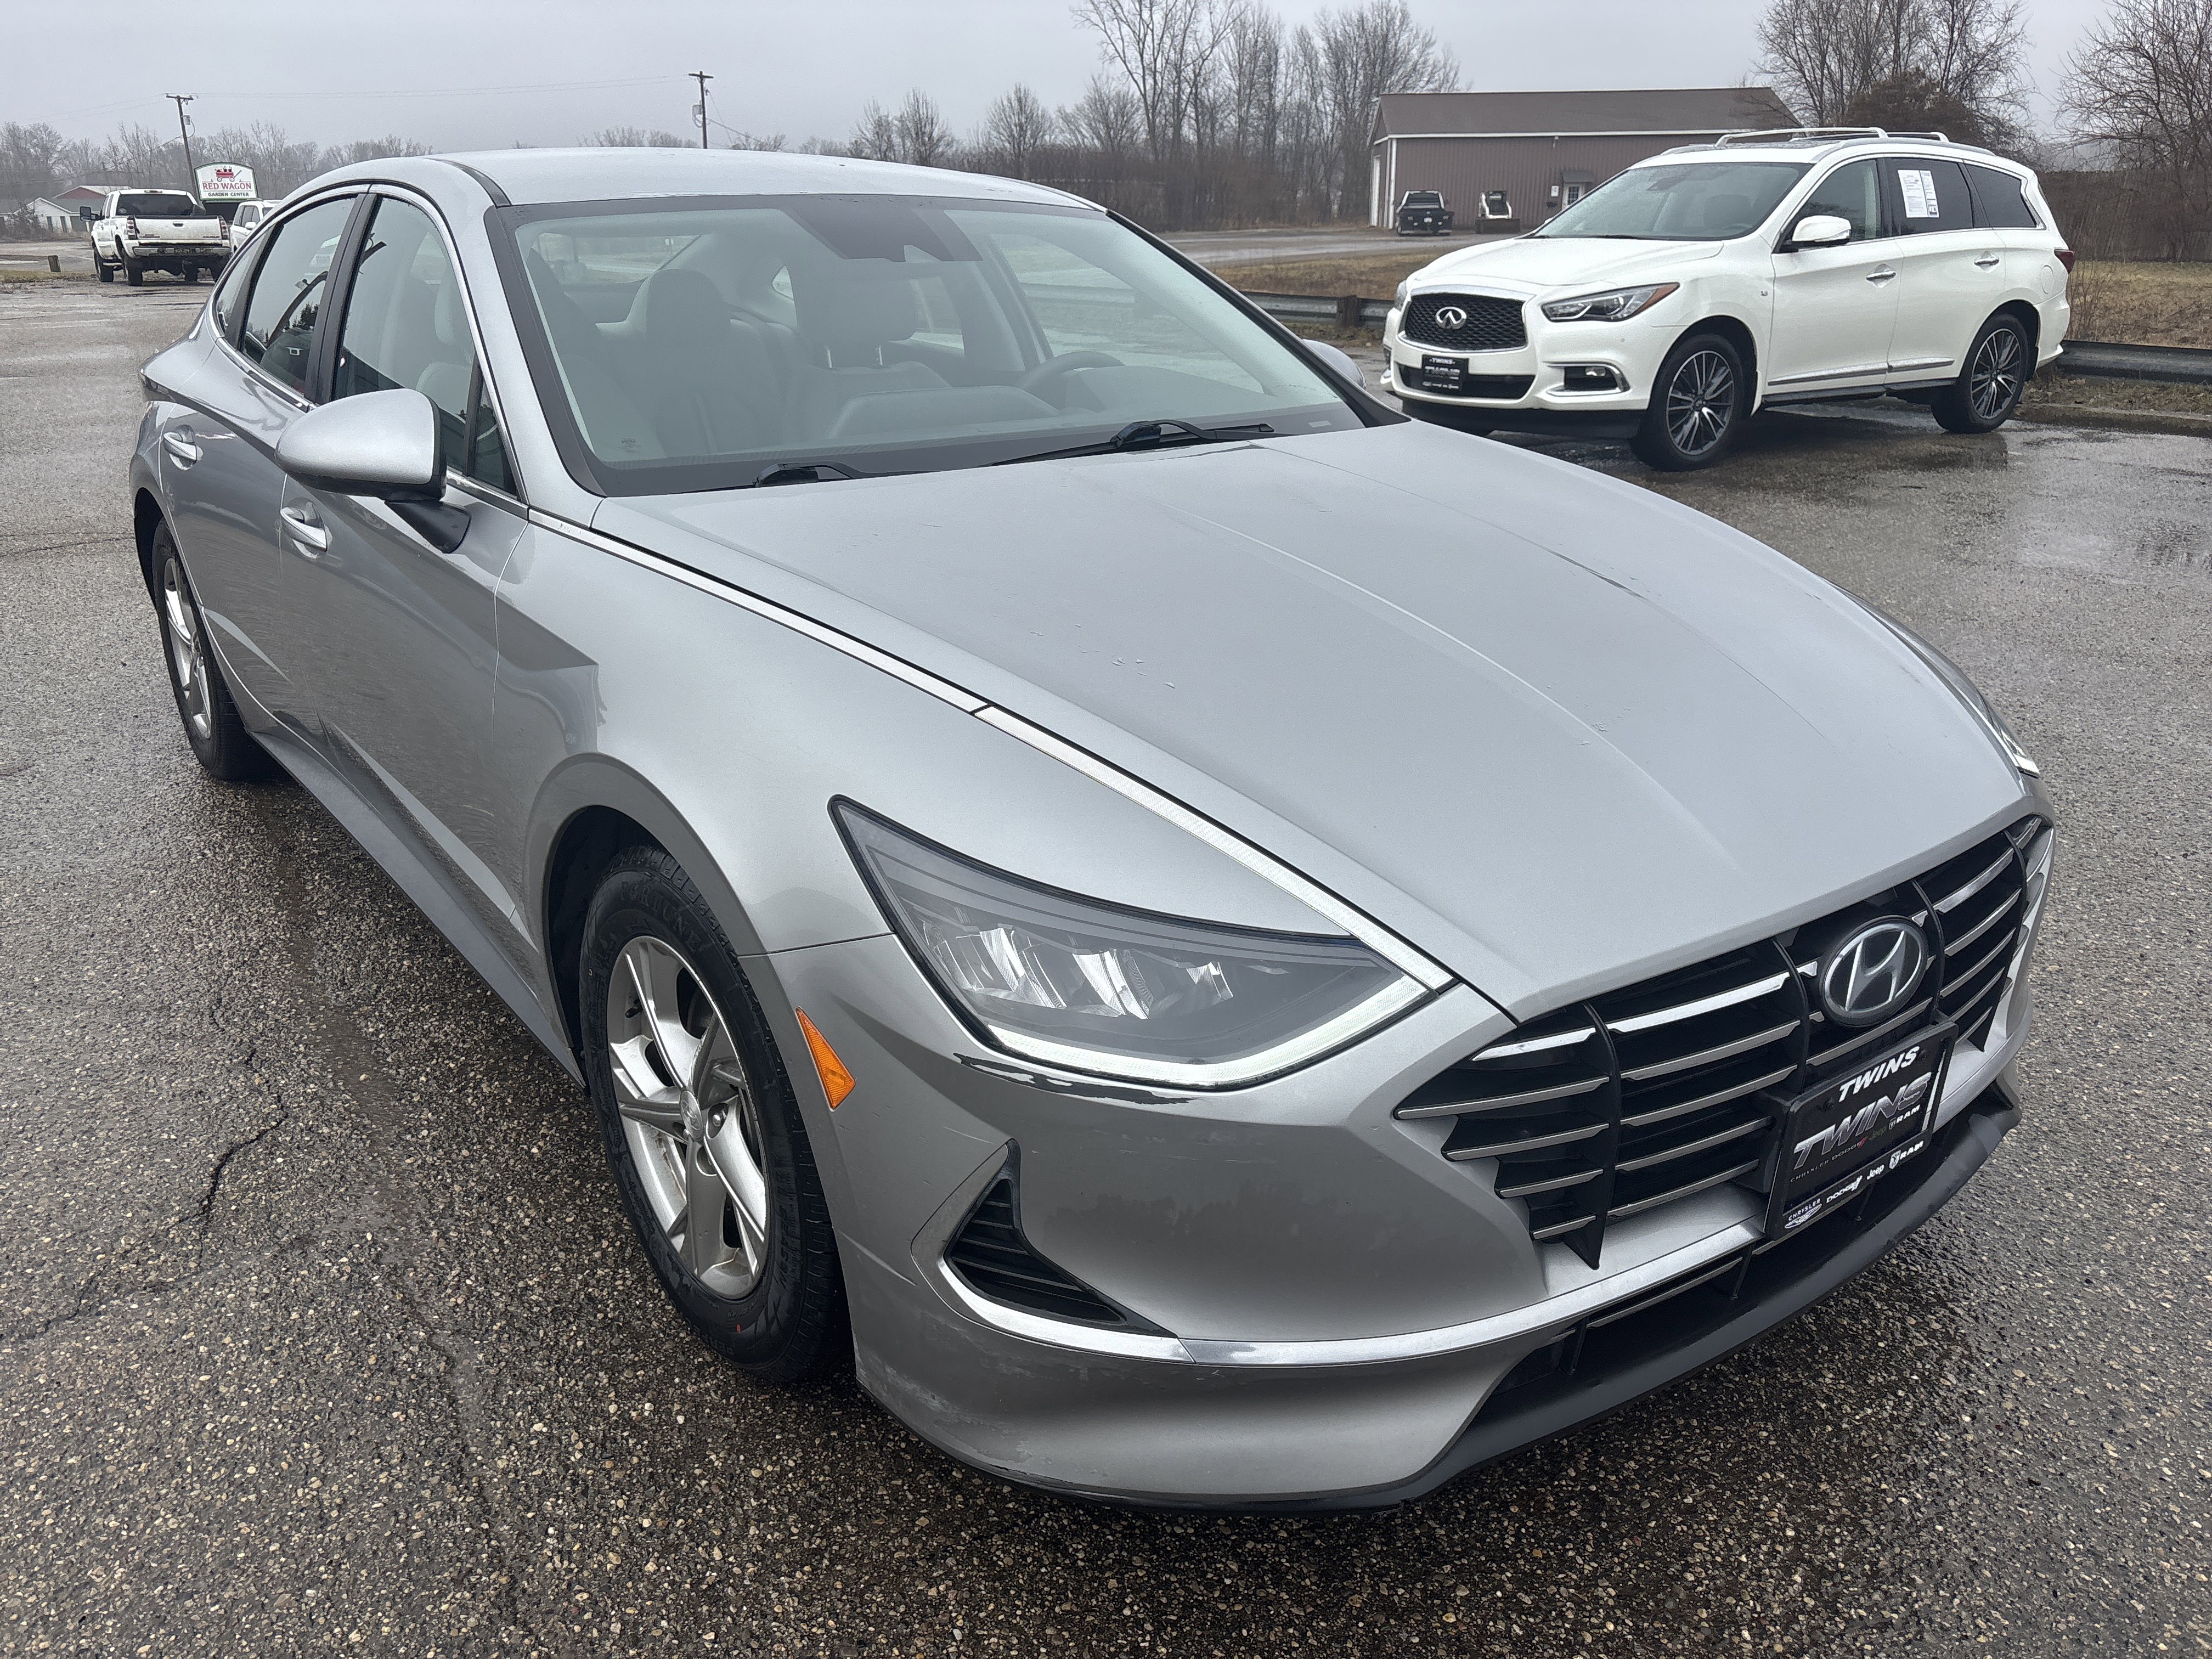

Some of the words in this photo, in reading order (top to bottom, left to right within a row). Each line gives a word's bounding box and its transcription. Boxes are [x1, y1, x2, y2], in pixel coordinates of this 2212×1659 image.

[1838, 1046, 1920, 1103] TWINS
[1790, 1159, 1829, 1182] CHRYSLER
[1832, 1141, 1863, 1160] DODGE
[1897, 1104, 1920, 1124] RAM
[1793, 1071, 1932, 1170] TWINS
[1788, 1198, 1821, 1221] CHRYSLER
[1826, 1180, 1859, 1204] DODGE
[1867, 1165, 1884, 1180] Jeep
[1900, 1141, 1924, 1160] RAM
